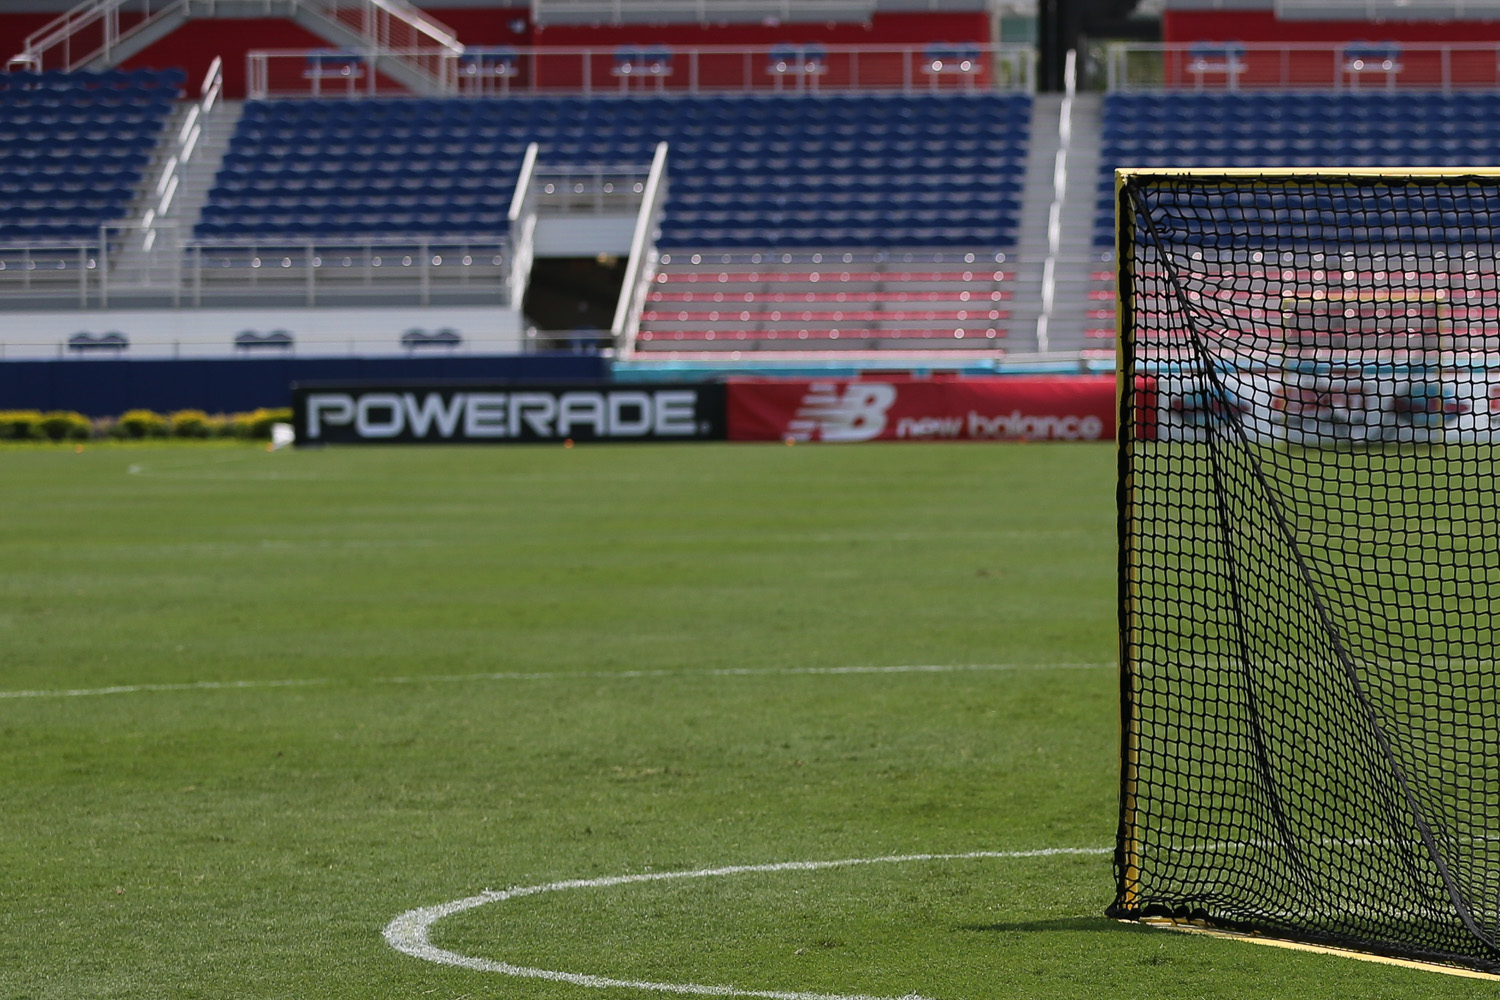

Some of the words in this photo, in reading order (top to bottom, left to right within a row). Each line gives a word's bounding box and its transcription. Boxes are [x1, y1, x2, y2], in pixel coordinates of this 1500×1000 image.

[306, 391, 697, 436] POWERADE
[896, 416, 963, 438] new
[967, 409, 1103, 439] balance
